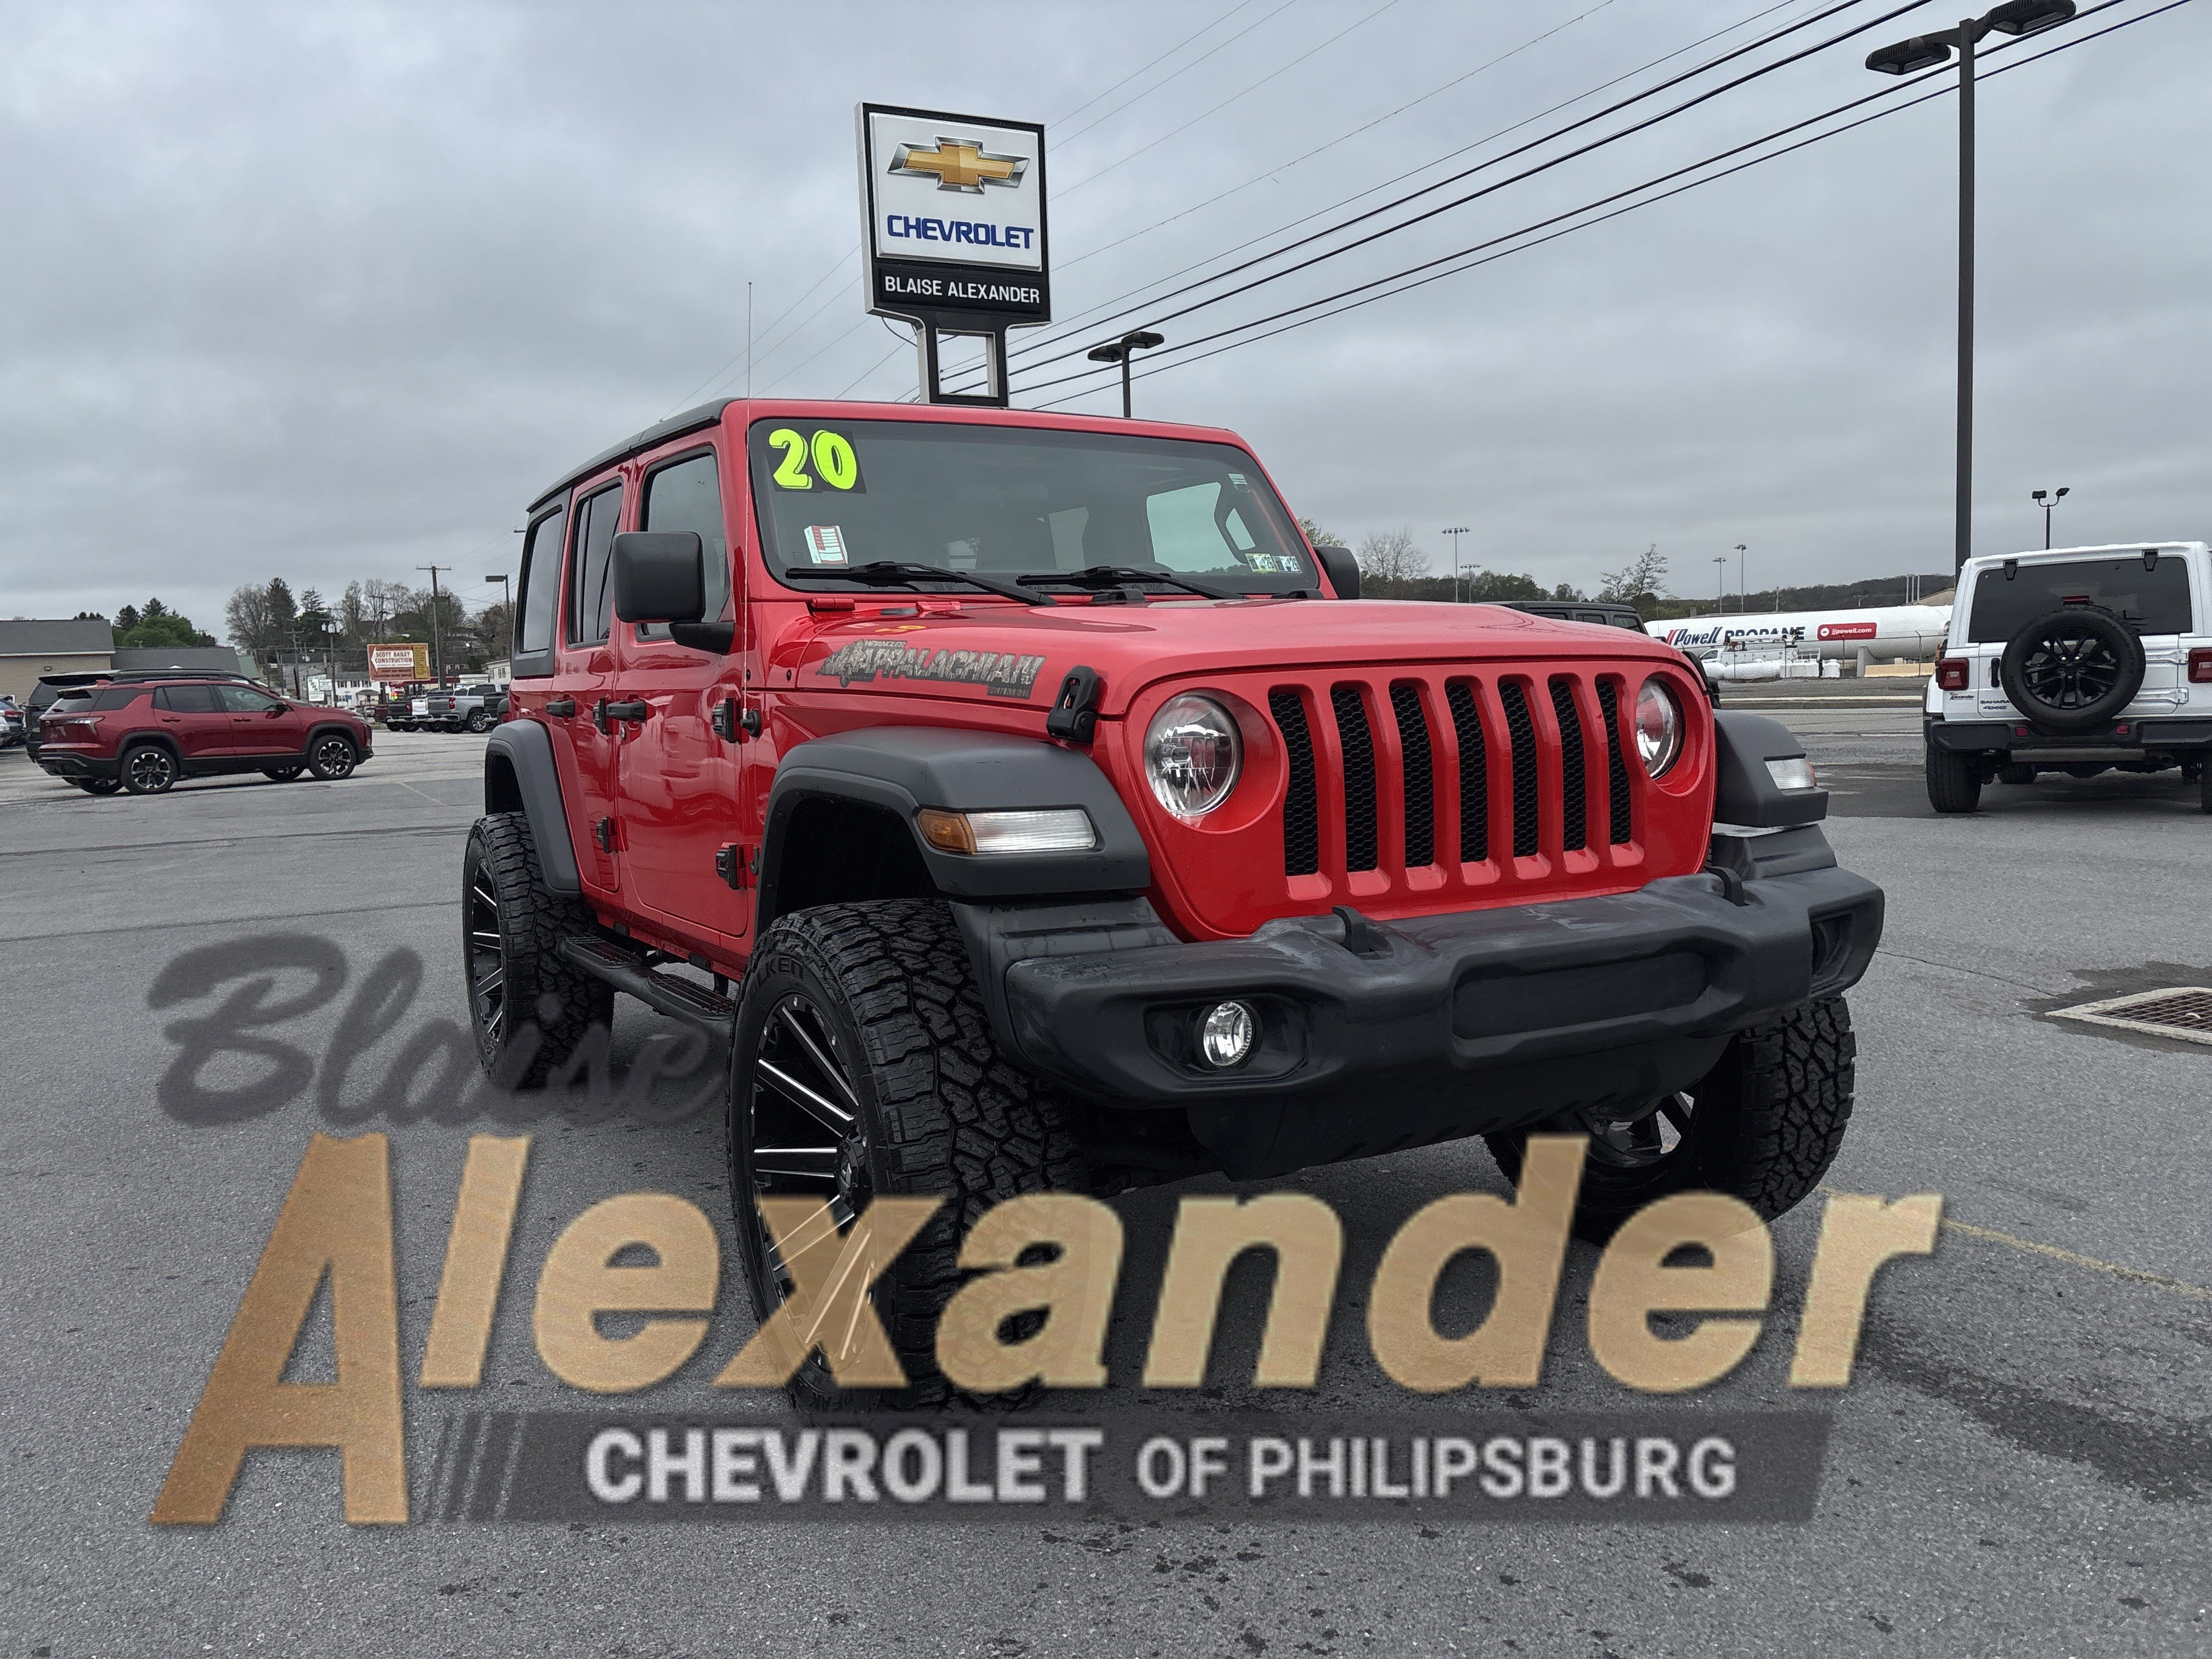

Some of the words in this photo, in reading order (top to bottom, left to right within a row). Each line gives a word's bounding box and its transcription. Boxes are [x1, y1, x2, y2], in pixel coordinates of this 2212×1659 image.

[887, 214, 1035, 249] CHEVROLET
[884, 275, 943, 297] BLAISE
[947, 281, 1040, 304] ALEXANDER
[769, 428, 857, 489] 20
